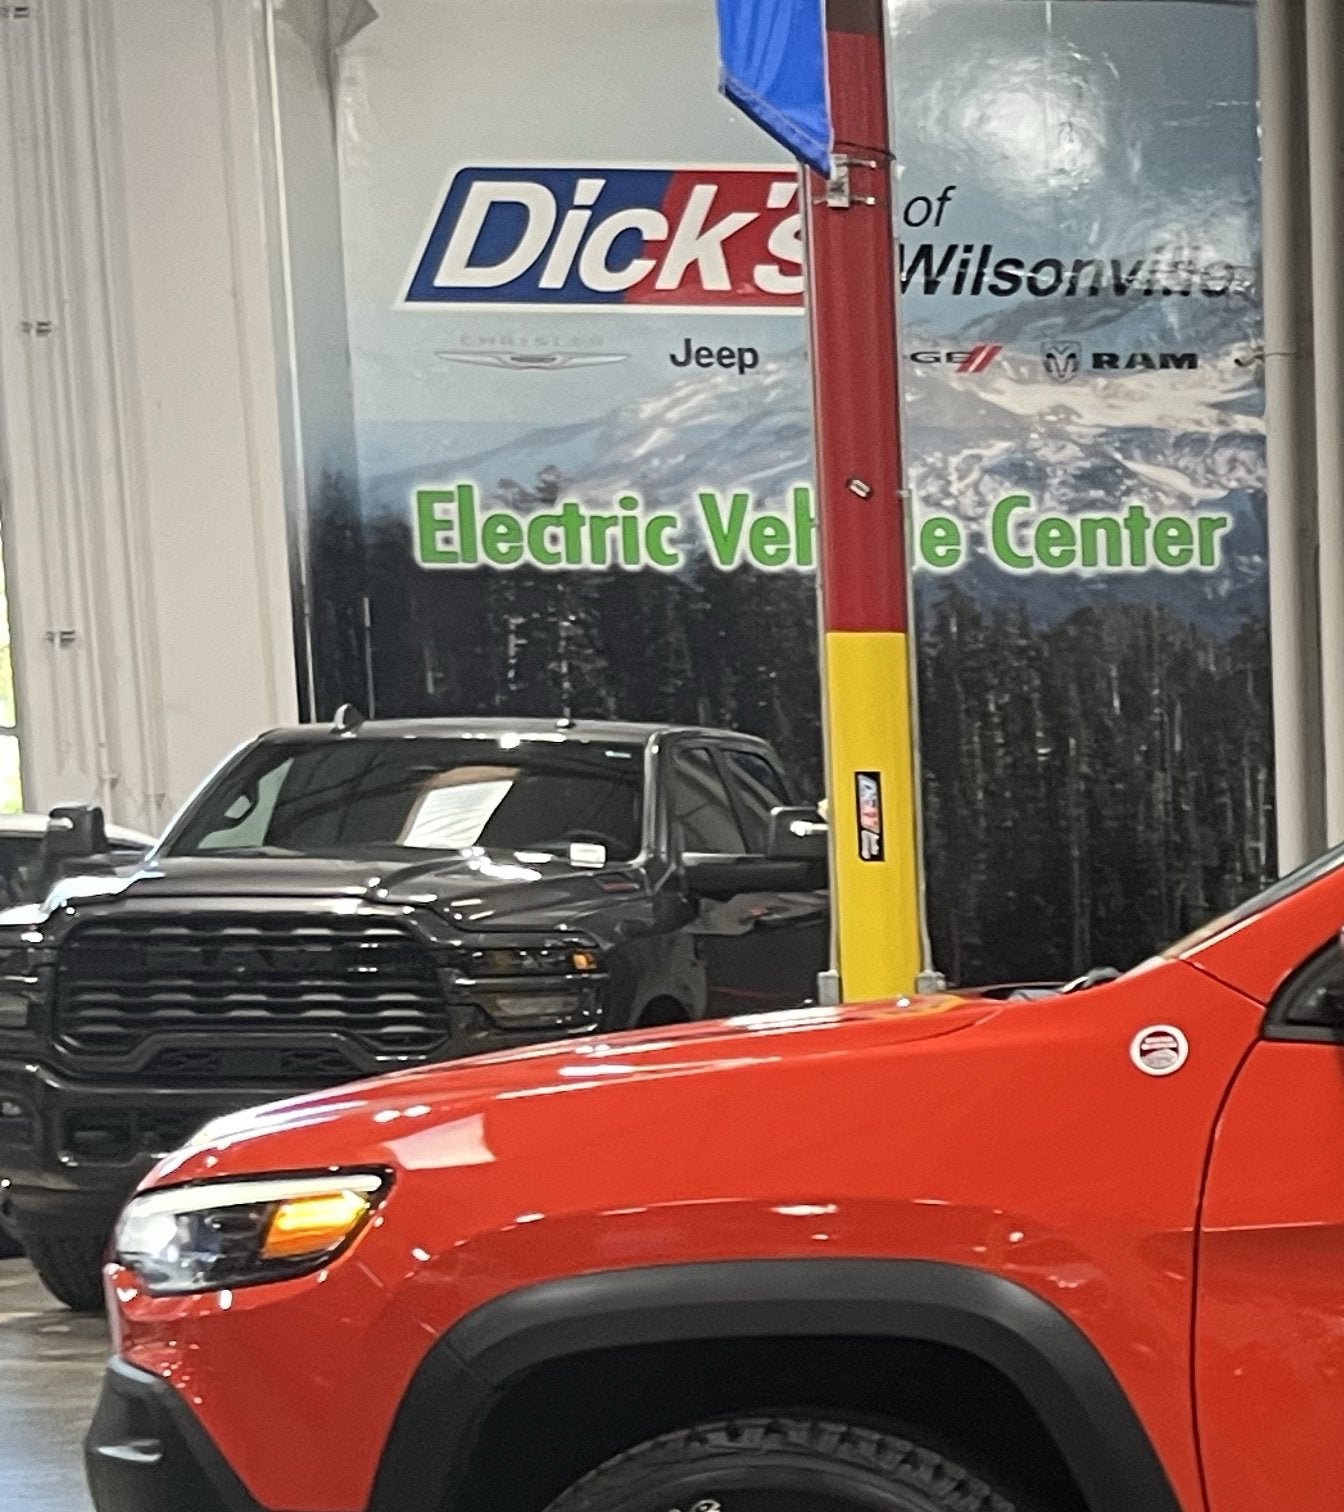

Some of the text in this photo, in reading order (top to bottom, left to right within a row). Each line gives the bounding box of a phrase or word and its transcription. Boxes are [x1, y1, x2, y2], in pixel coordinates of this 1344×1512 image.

[433, 178, 957, 294] Dick's of
[669, 337, 759, 375] Jeep
[1091, 352, 1198, 369] RAM
[416, 484, 679, 566] Electric
[992, 495, 1227, 568] Center
